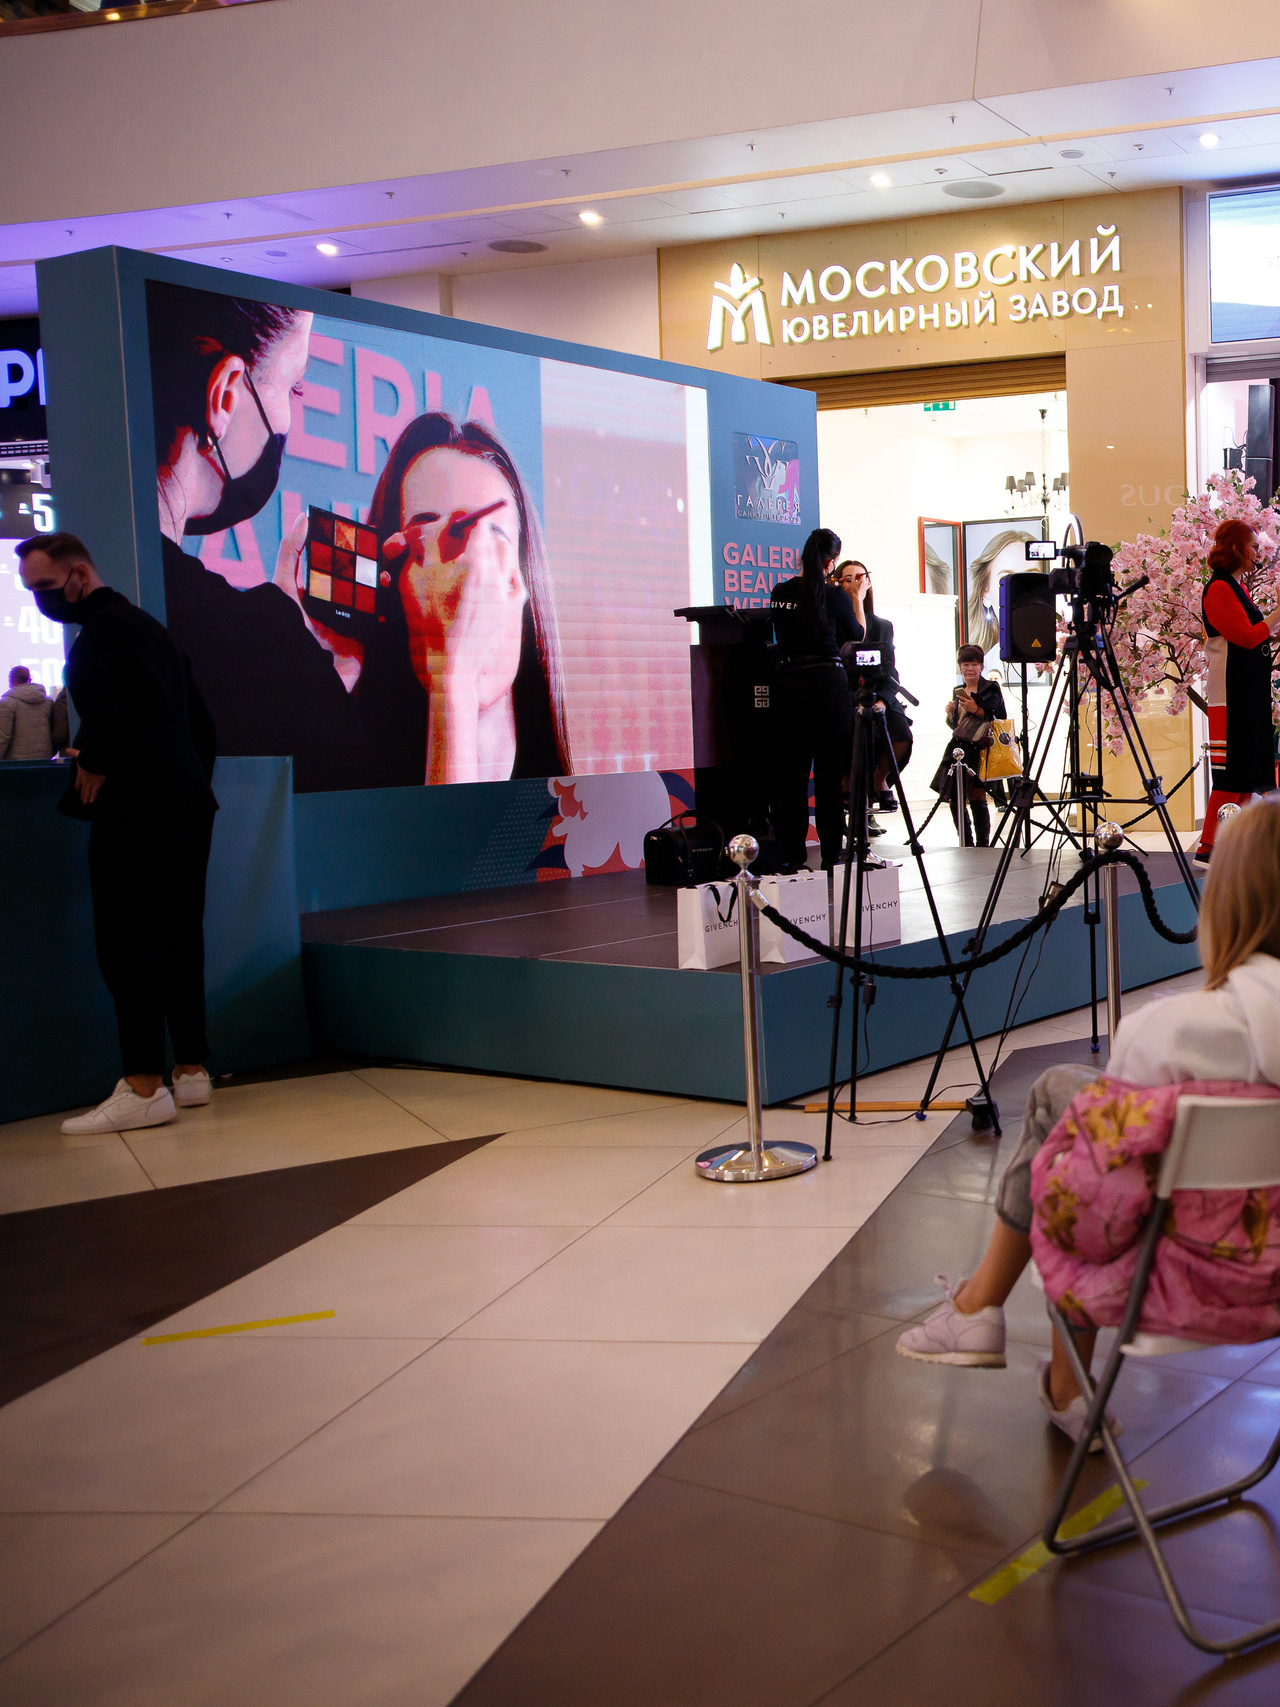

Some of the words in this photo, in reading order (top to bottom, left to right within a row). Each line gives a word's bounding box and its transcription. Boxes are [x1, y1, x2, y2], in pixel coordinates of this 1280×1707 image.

[780, 224, 1121, 308] МОСКОВСКИЙ
[781, 290, 997, 344] ЮВЕЛИРНЫЙ
[1008, 284, 1125, 322] ЗАВОД
[736, 493, 801, 513] ГАЛЕРЕЯ
[722, 541, 801, 570] GALERI
[861, 900, 898, 912] IVENCHY
[704, 919, 739, 933] GIVENCH
[789, 913, 827, 925] VENCHY
